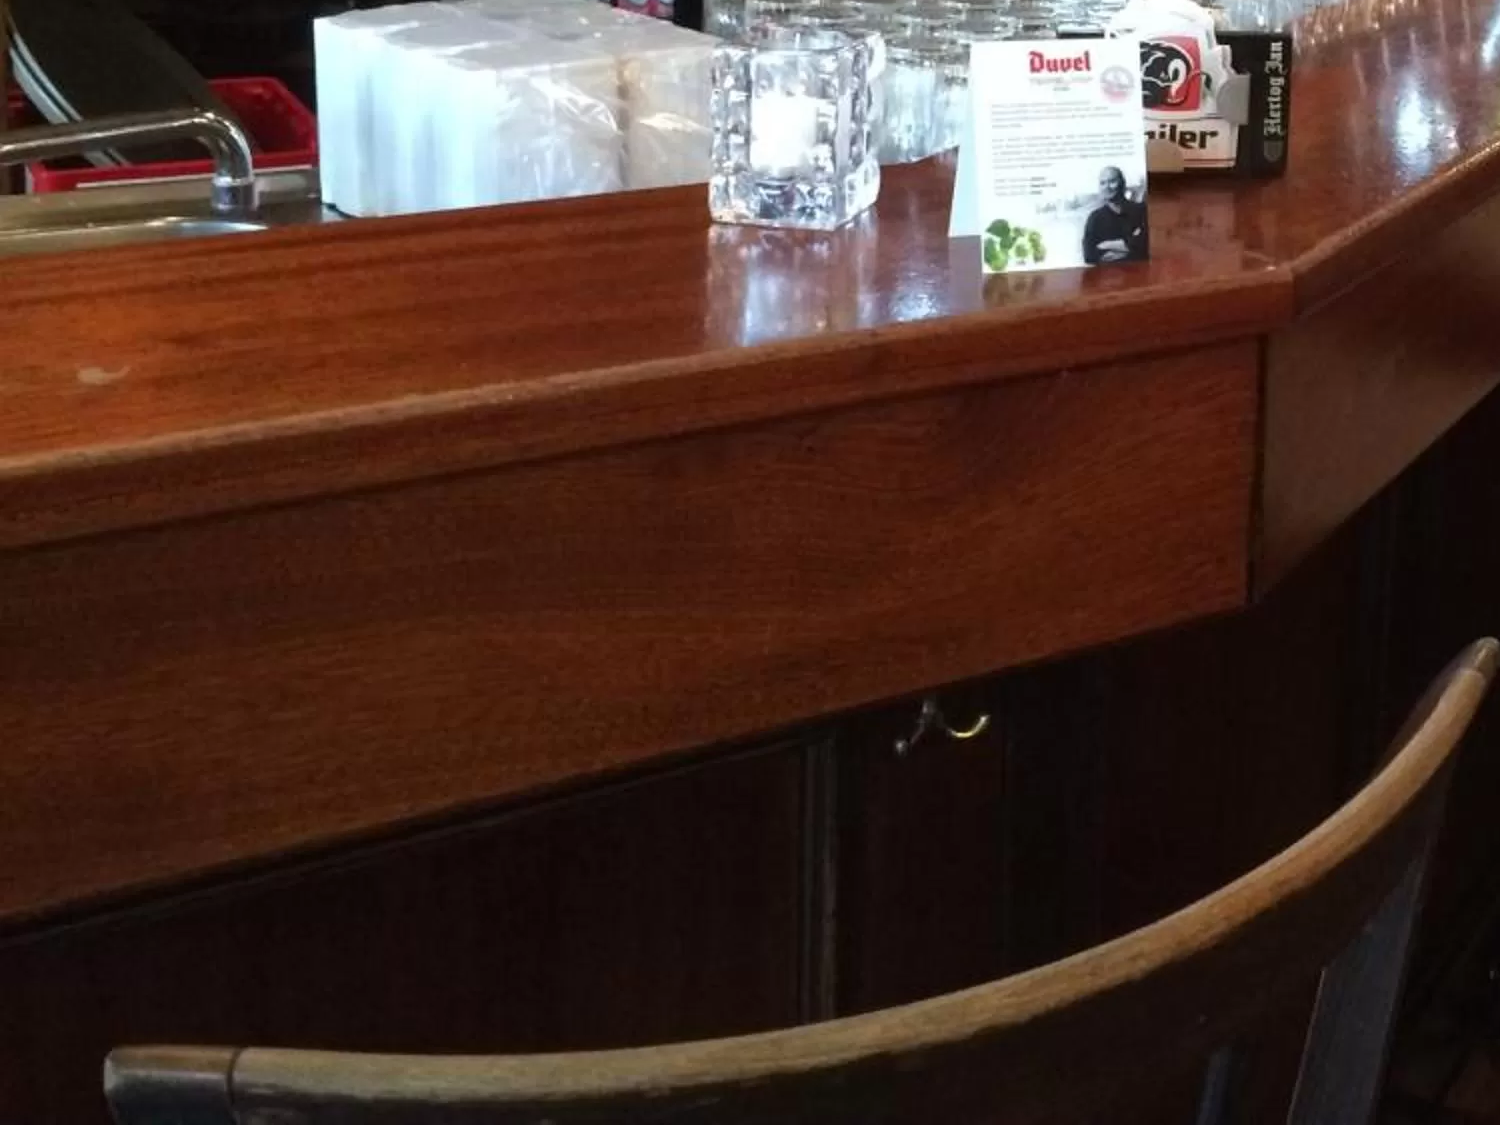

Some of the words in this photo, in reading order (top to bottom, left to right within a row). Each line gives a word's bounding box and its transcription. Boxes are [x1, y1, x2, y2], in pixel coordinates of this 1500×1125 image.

[1028, 50, 1092, 73] Duvel
[1264, 41, 1286, 75] Jan
[1263, 76, 1285, 137] Hertog
